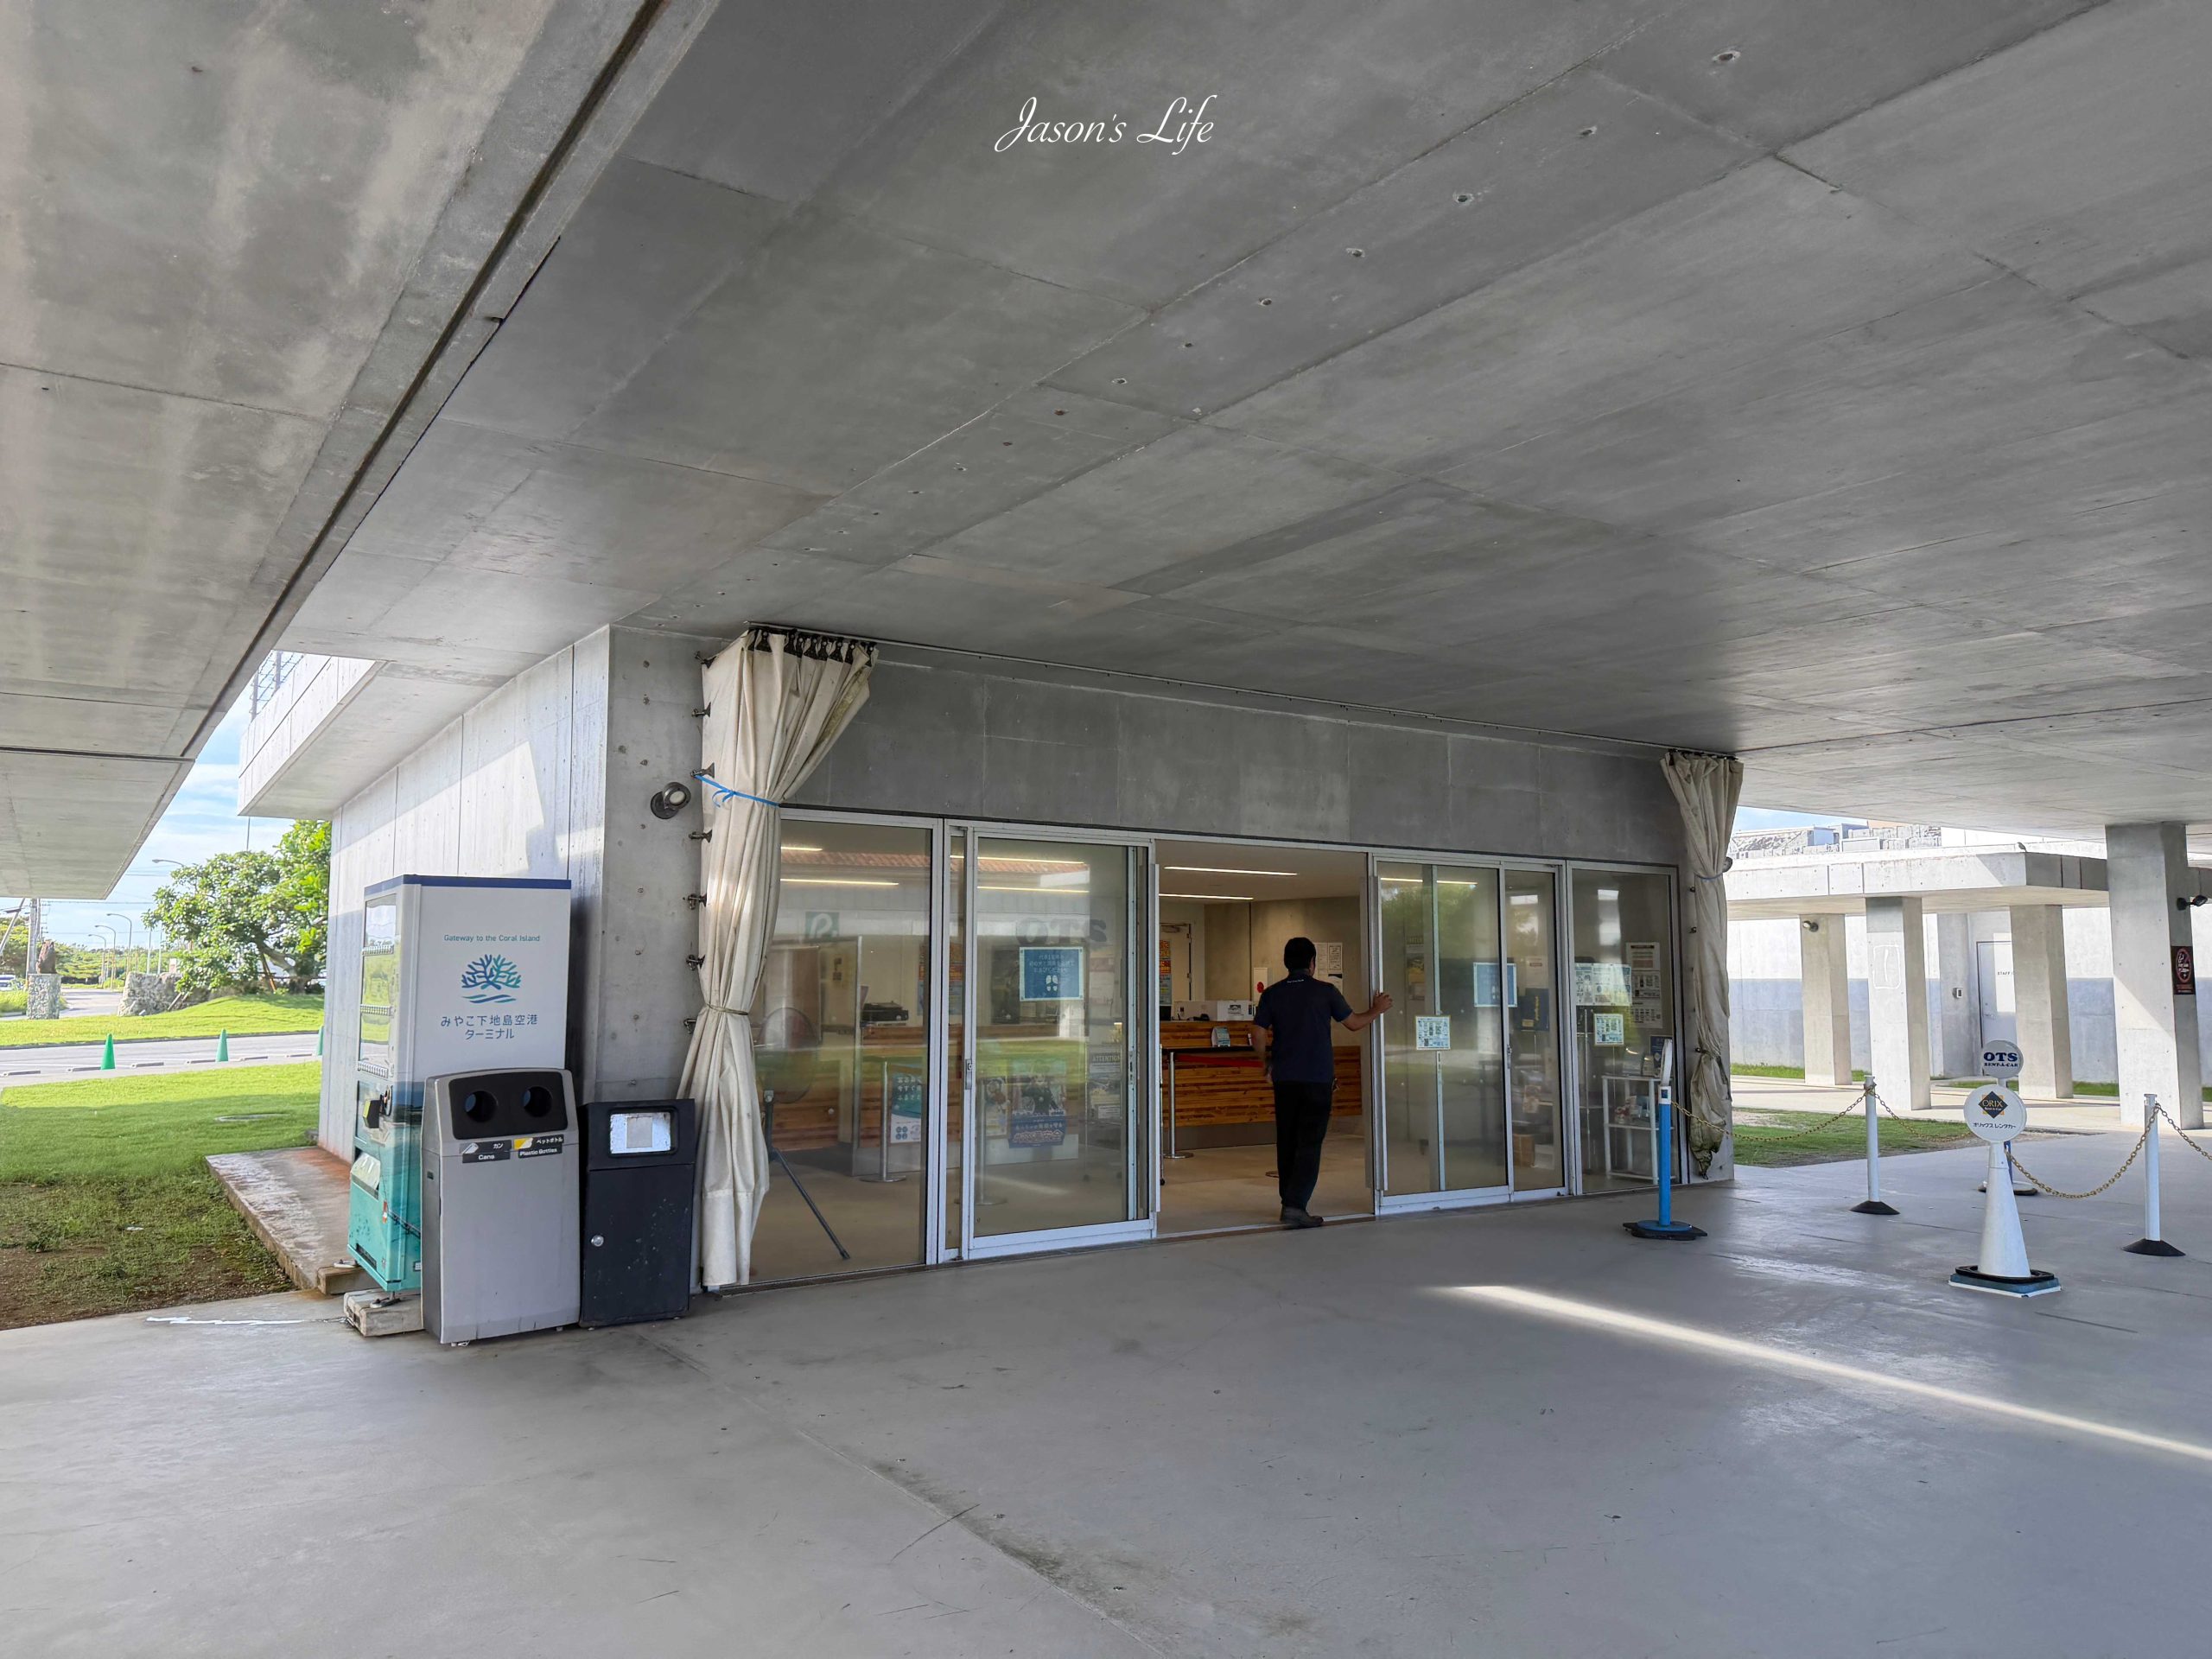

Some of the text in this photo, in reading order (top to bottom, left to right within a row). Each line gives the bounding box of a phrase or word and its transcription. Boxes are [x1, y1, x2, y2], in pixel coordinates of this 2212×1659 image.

[444, 934, 474, 943] Gateway
[441, 1014, 537, 1027] みやこ下地島空港
[465, 1028, 514, 1039] ターミナル
[1983, 1052, 2018, 1062] OTS
[1982, 1099, 2003, 1108] ORIX
